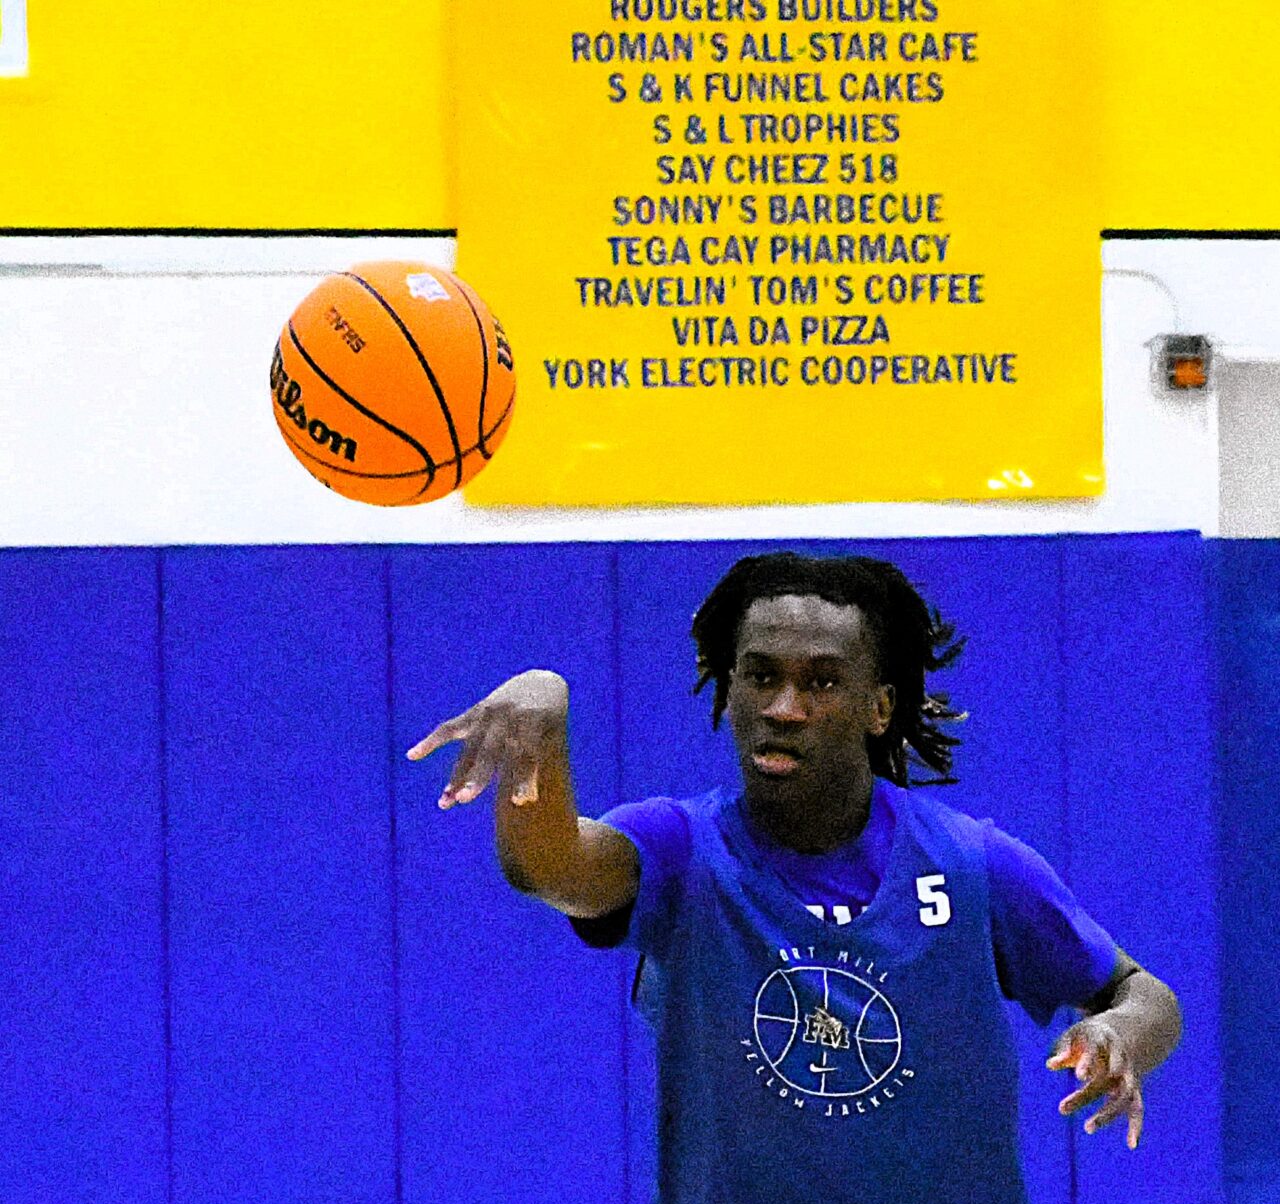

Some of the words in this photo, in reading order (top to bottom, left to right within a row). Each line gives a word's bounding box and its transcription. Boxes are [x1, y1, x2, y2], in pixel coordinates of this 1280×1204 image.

[778, 0, 939, 24] BUILDERS
[572, 32, 730, 64] ROMAN'S
[741, 32, 888, 64] ALL-STAR
[899, 33, 978, 63] CAFE
[609, 73, 628, 105] S
[639, 73, 663, 104] &
[675, 74, 694, 104] K
[705, 73, 830, 104] FUNNEL
[840, 72, 946, 104] CAKES
[654, 115, 673, 145] S
[685, 115, 708, 146] &
[719, 115, 734, 145] L
[740, 114, 901, 145] TROPHIES
[657, 155, 716, 186] SAY
[726, 154, 831, 186] CHEEZ
[840, 153, 898, 185] 518
[614, 195, 759, 228] SONNY'S
[769, 193, 942, 226] BARBECUE
[608, 236, 692, 267] TEGA
[701, 235, 760, 267] CAY
[771, 234, 951, 266] PHARMACY
[576, 277, 738, 309] TRAVELIN'
[751, 275, 856, 307] TOM'S
[865, 274, 985, 306] COFFEE
[673, 317, 740, 348] VITA
[750, 316, 792, 347] DA
[801, 315, 891, 347] PIZZA
[544, 359, 631, 391] YORK
[642, 357, 790, 389] ELECTRIC
[801, 354, 1018, 387] COOPERATIVE
[915, 874, 951, 927] 5
[837, 951, 888, 983] MILL
[824, 1068, 915, 1117] JACKETS
